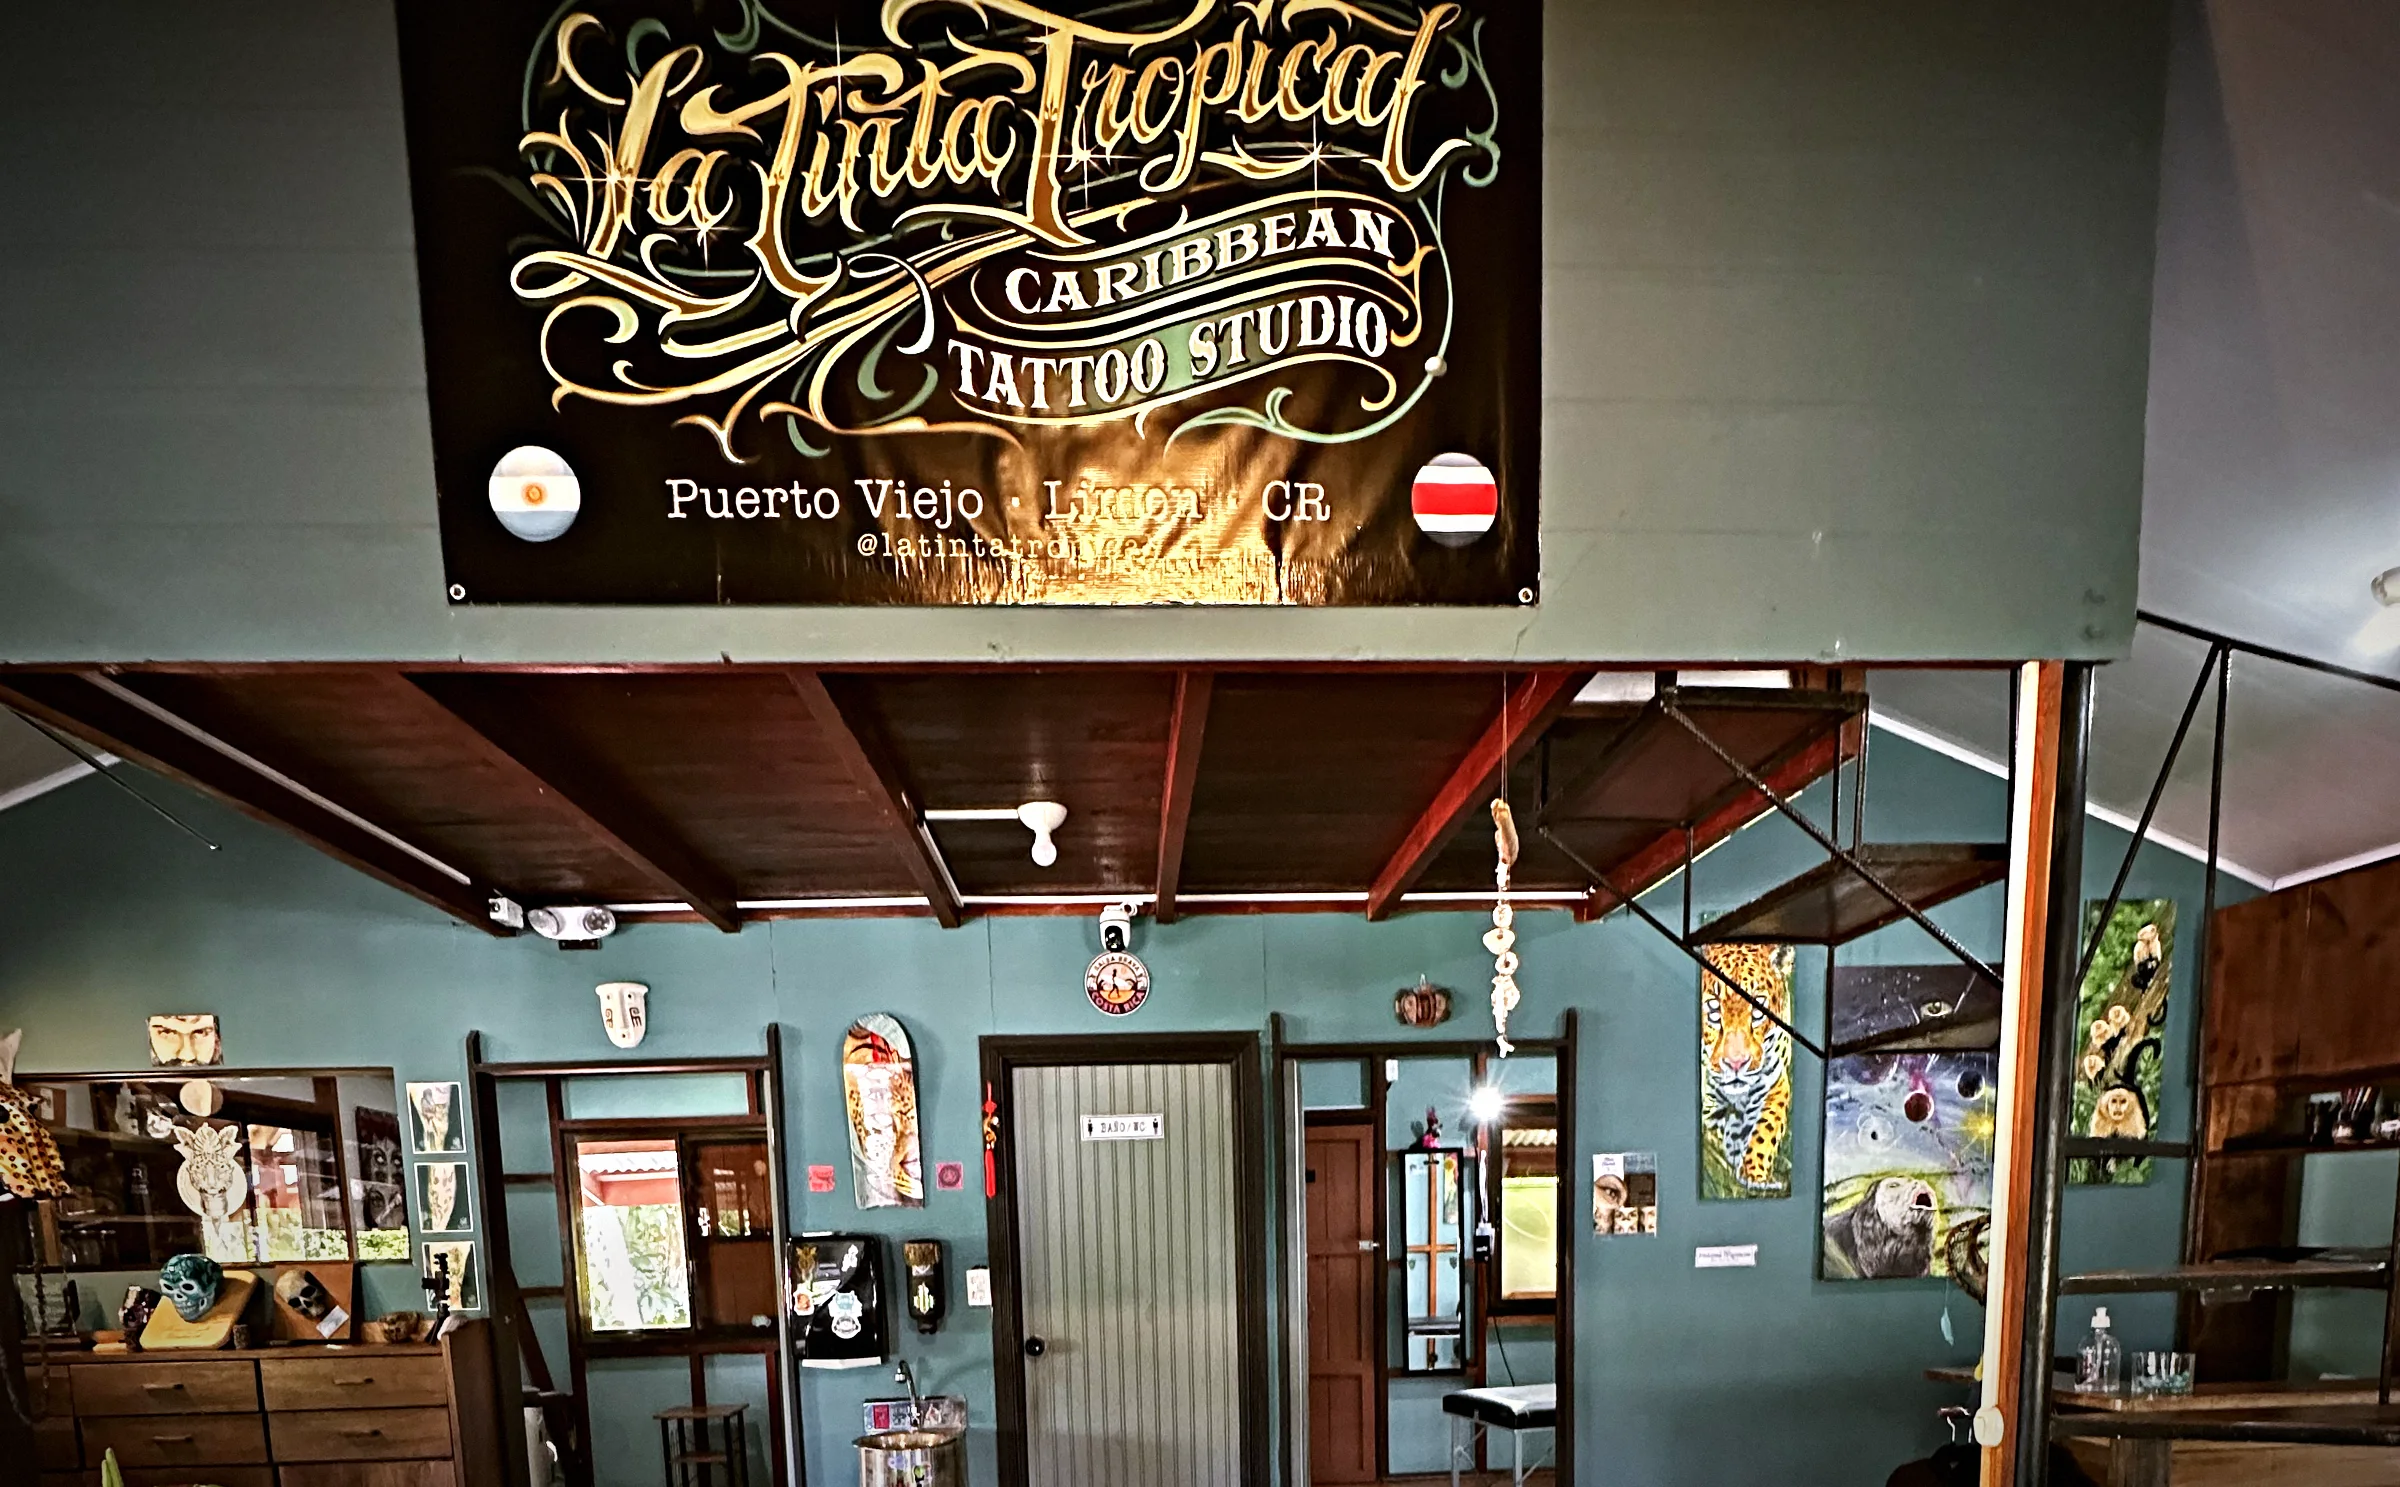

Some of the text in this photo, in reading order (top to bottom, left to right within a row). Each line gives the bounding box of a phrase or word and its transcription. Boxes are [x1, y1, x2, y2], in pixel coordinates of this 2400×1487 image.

[680, 42, 1024, 312] Tinta
[985, 0, 1470, 248] Tropical
[1004, 206, 1396, 315] CARIBBEAN
[945, 294, 1389, 410] TATTOO STUDIO
[665, 478, 841, 520] Puerto
[854, 478, 985, 530] Viejo
[1261, 480, 1332, 522] CR
[857, 532, 1162, 566] @latintatropca
[1118, 956, 1141, 971] BRAVA
[1091, 991, 1145, 1014] COSTA RICA
